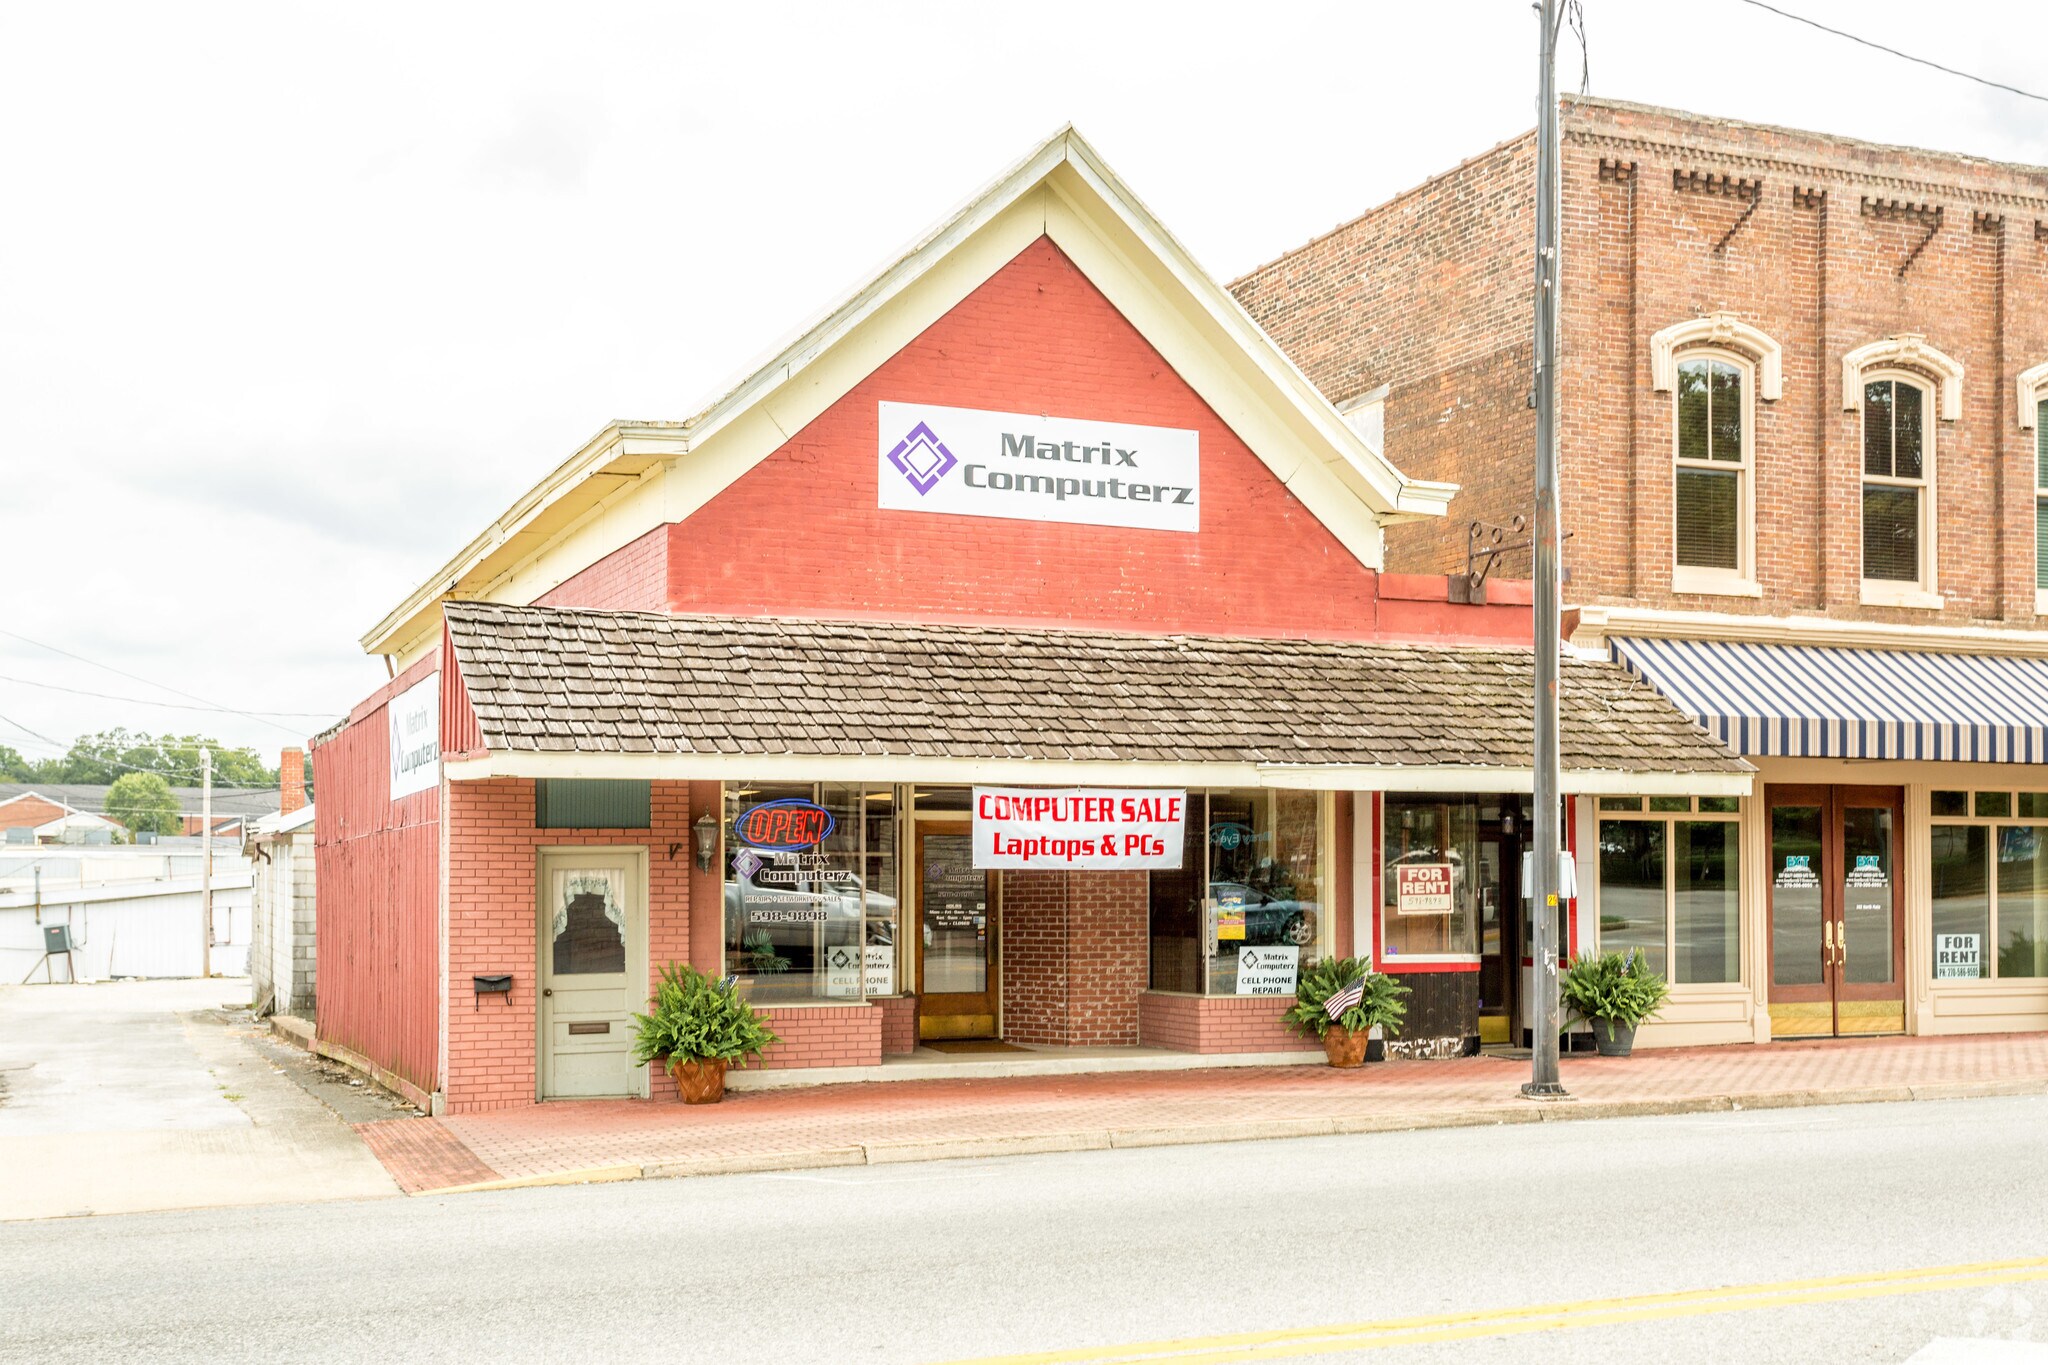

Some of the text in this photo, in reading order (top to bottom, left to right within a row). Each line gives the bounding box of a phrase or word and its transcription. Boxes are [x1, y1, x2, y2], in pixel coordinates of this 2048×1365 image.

[1001, 432, 1138, 468] Matrix
[963, 464, 1195, 505] Computerz
[406, 705, 428, 737] Matrix
[401, 741, 438, 775] Computerz
[979, 794, 1181, 822] COMPUTER SALE
[748, 809, 824, 844] OPEN
[993, 832, 1164, 862] Laptops & PCs
[773, 852, 830, 866] Matrix
[1786, 855, 1810, 868] EXIT
[1856, 855, 1880, 868] EXIT
[760, 868, 852, 885] Computerz
[1407, 868, 1443, 881] FOR
[1402, 881, 1449, 894] RENT
[751, 910, 828, 922] 598-9898
[1944, 936, 1973, 949] FOR
[1939, 951, 1978, 963] RENT
[847, 962, 890, 970] Comuterz
[1256, 963, 1295, 971] Computerz
[832, 977, 854, 985] CELL
